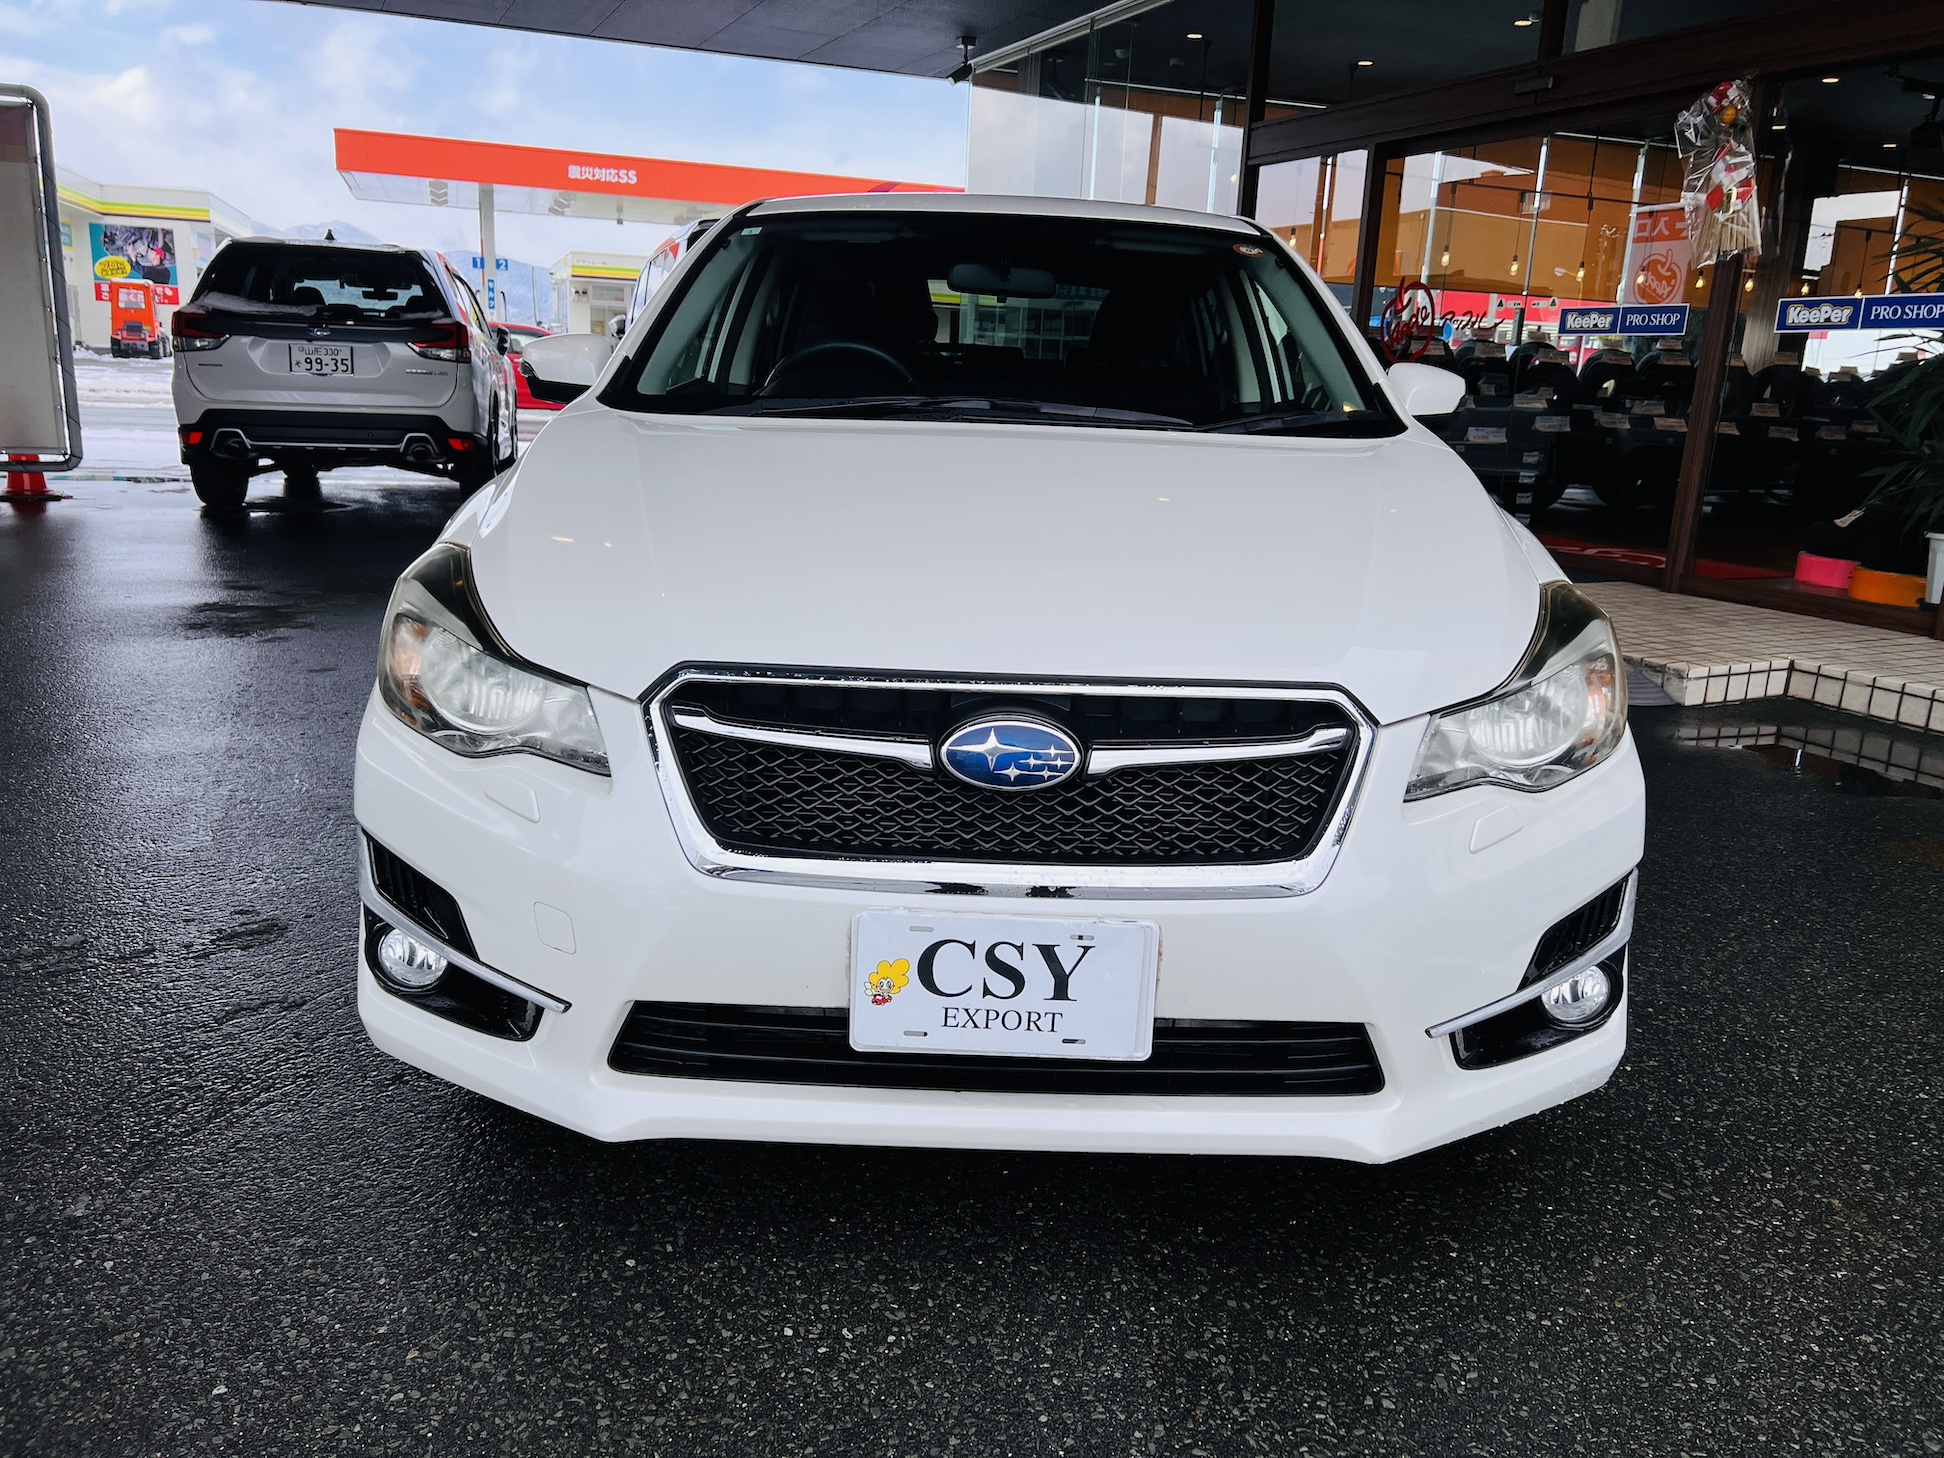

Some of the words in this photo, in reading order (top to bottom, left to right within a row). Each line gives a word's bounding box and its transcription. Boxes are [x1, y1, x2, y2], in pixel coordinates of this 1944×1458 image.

[567, 164, 638, 185] 震災対応SS
[475, 257, 482, 268] 1
[498, 260, 507, 270] 2
[1565, 311, 1614, 330] KeePer
[1626, 314, 1649, 326] PRO
[1649, 312, 1681, 326] SHOP
[1786, 303, 1853, 326] KeePer
[1870, 305, 1902, 320] PRO
[1902, 304, 1944, 320] SHOP
[323, 347, 339, 356] 330
[304, 357, 349, 373] 99-35
[917, 938, 1096, 1003] CSY
[941, 1006, 1064, 1034] EXPORT
